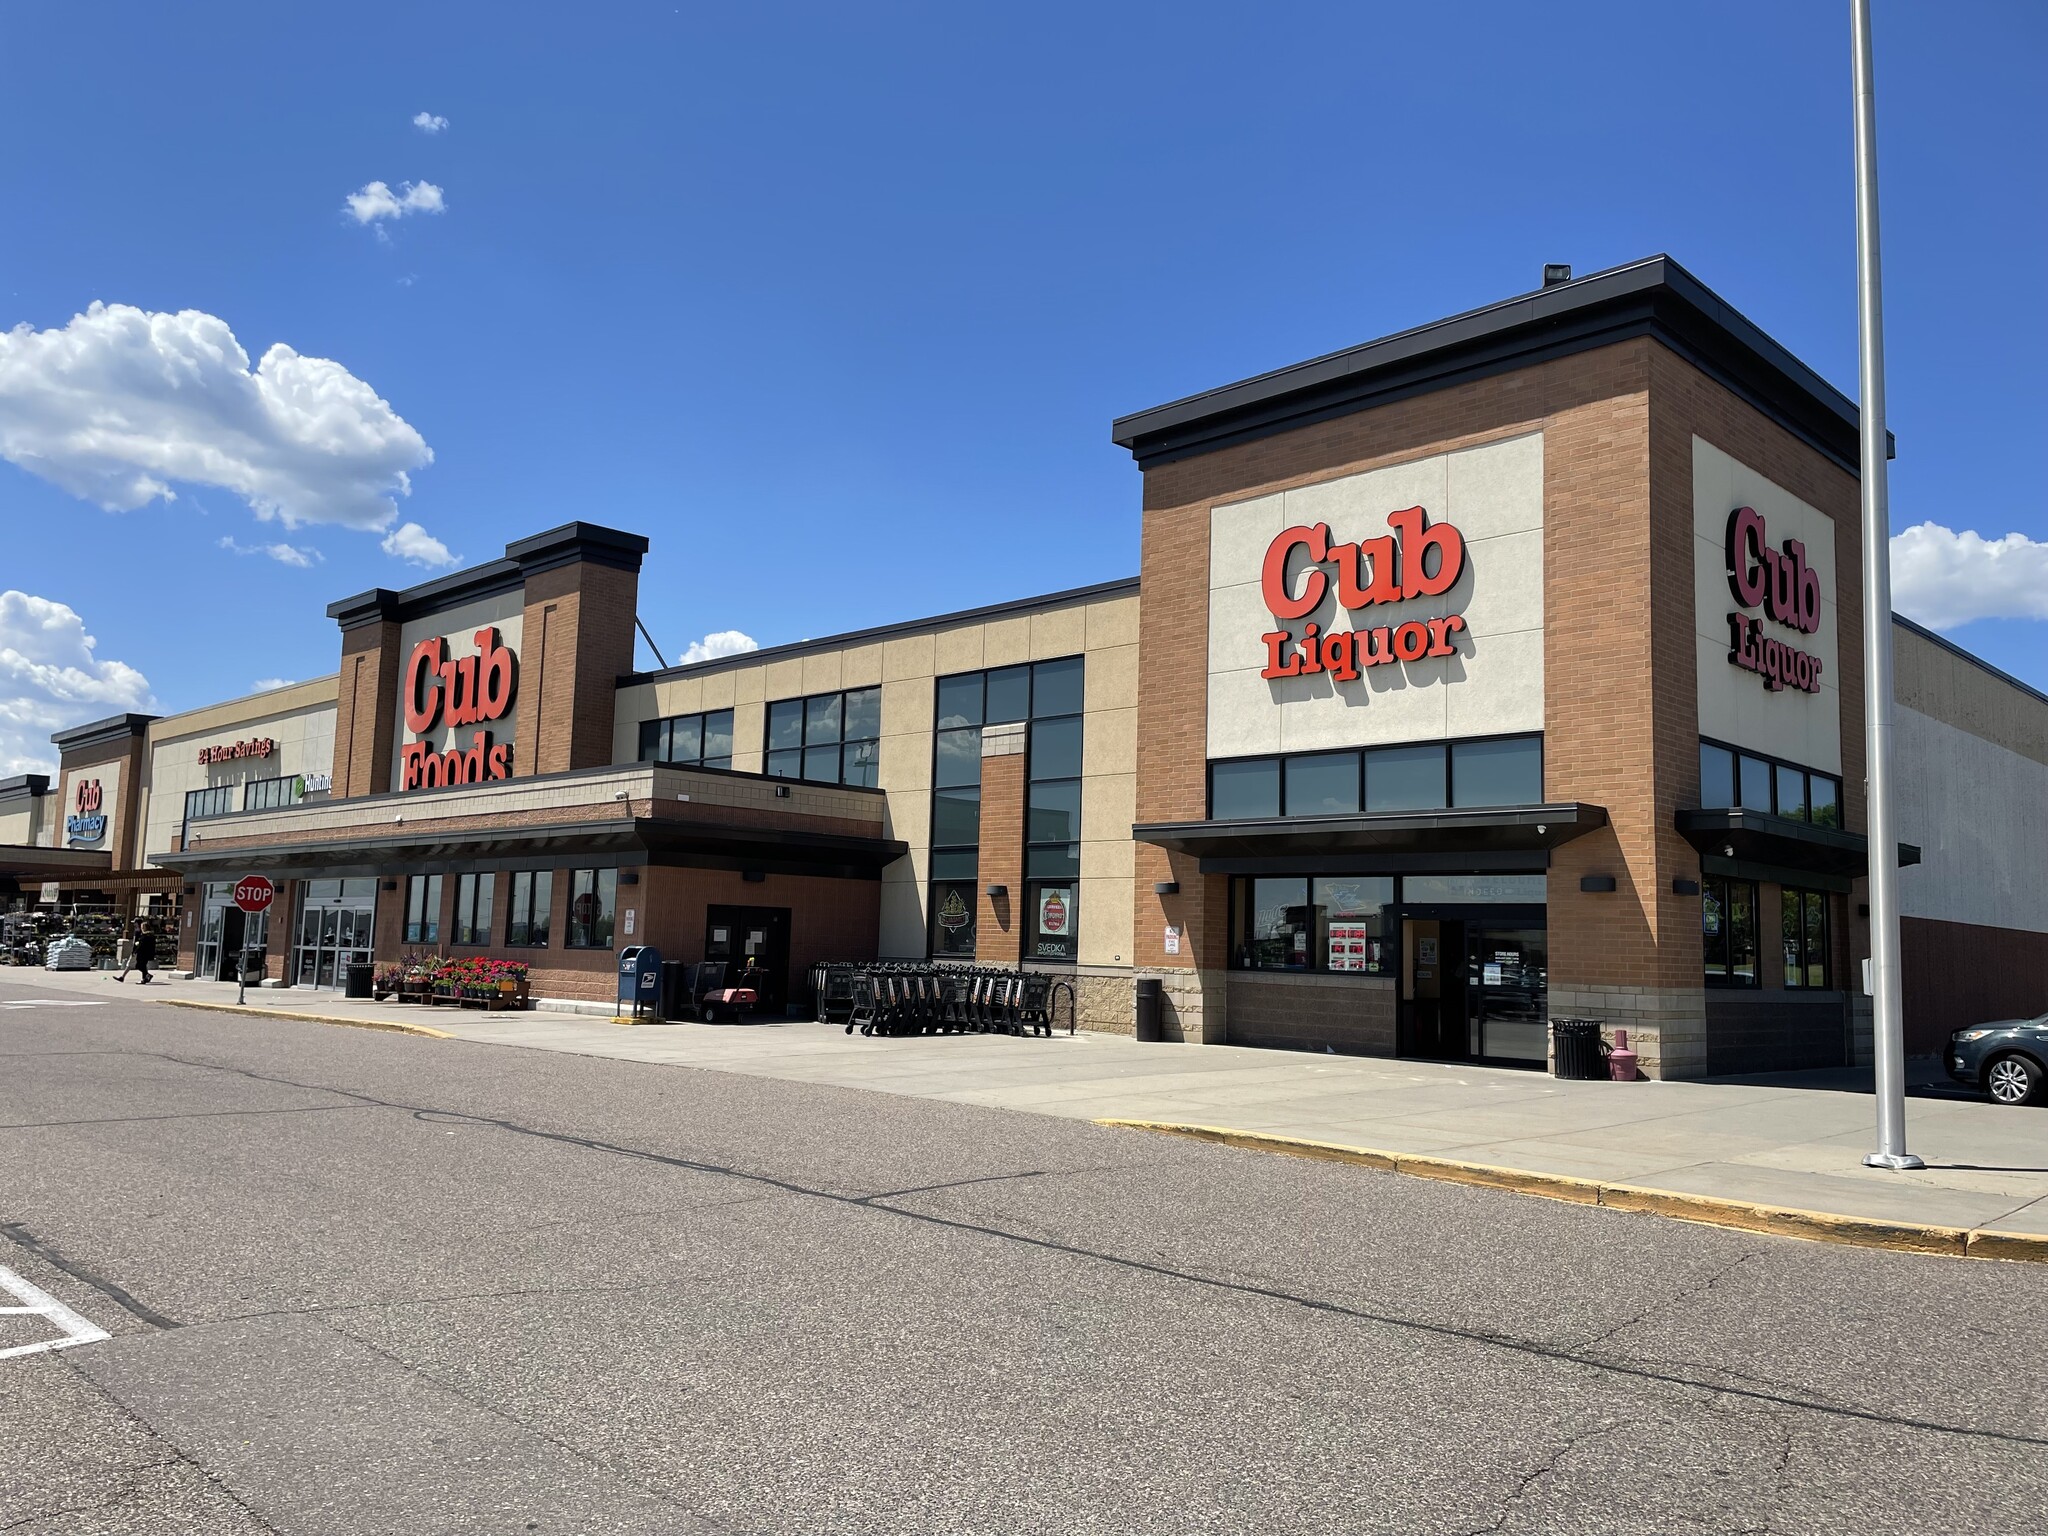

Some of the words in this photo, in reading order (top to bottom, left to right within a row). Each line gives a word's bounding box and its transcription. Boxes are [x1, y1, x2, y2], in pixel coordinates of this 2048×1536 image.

[1262, 505, 1464, 619] Cub
[1727, 506, 1821, 634] Cub
[1261, 615, 1464, 682] Liquor
[1729, 612, 1823, 693] Liquor
[404, 626, 514, 734] Cub
[198, 748, 209, 765] 24
[210, 746, 234, 763] Hour
[235, 738, 272, 759] Savings
[402, 730, 509, 791] Foods
[67, 815, 105, 834] Pharmacy
[76, 779, 101, 812] Cub
[236, 886, 272, 902] STOP
[1037, 942, 1066, 952] SVEDKA
